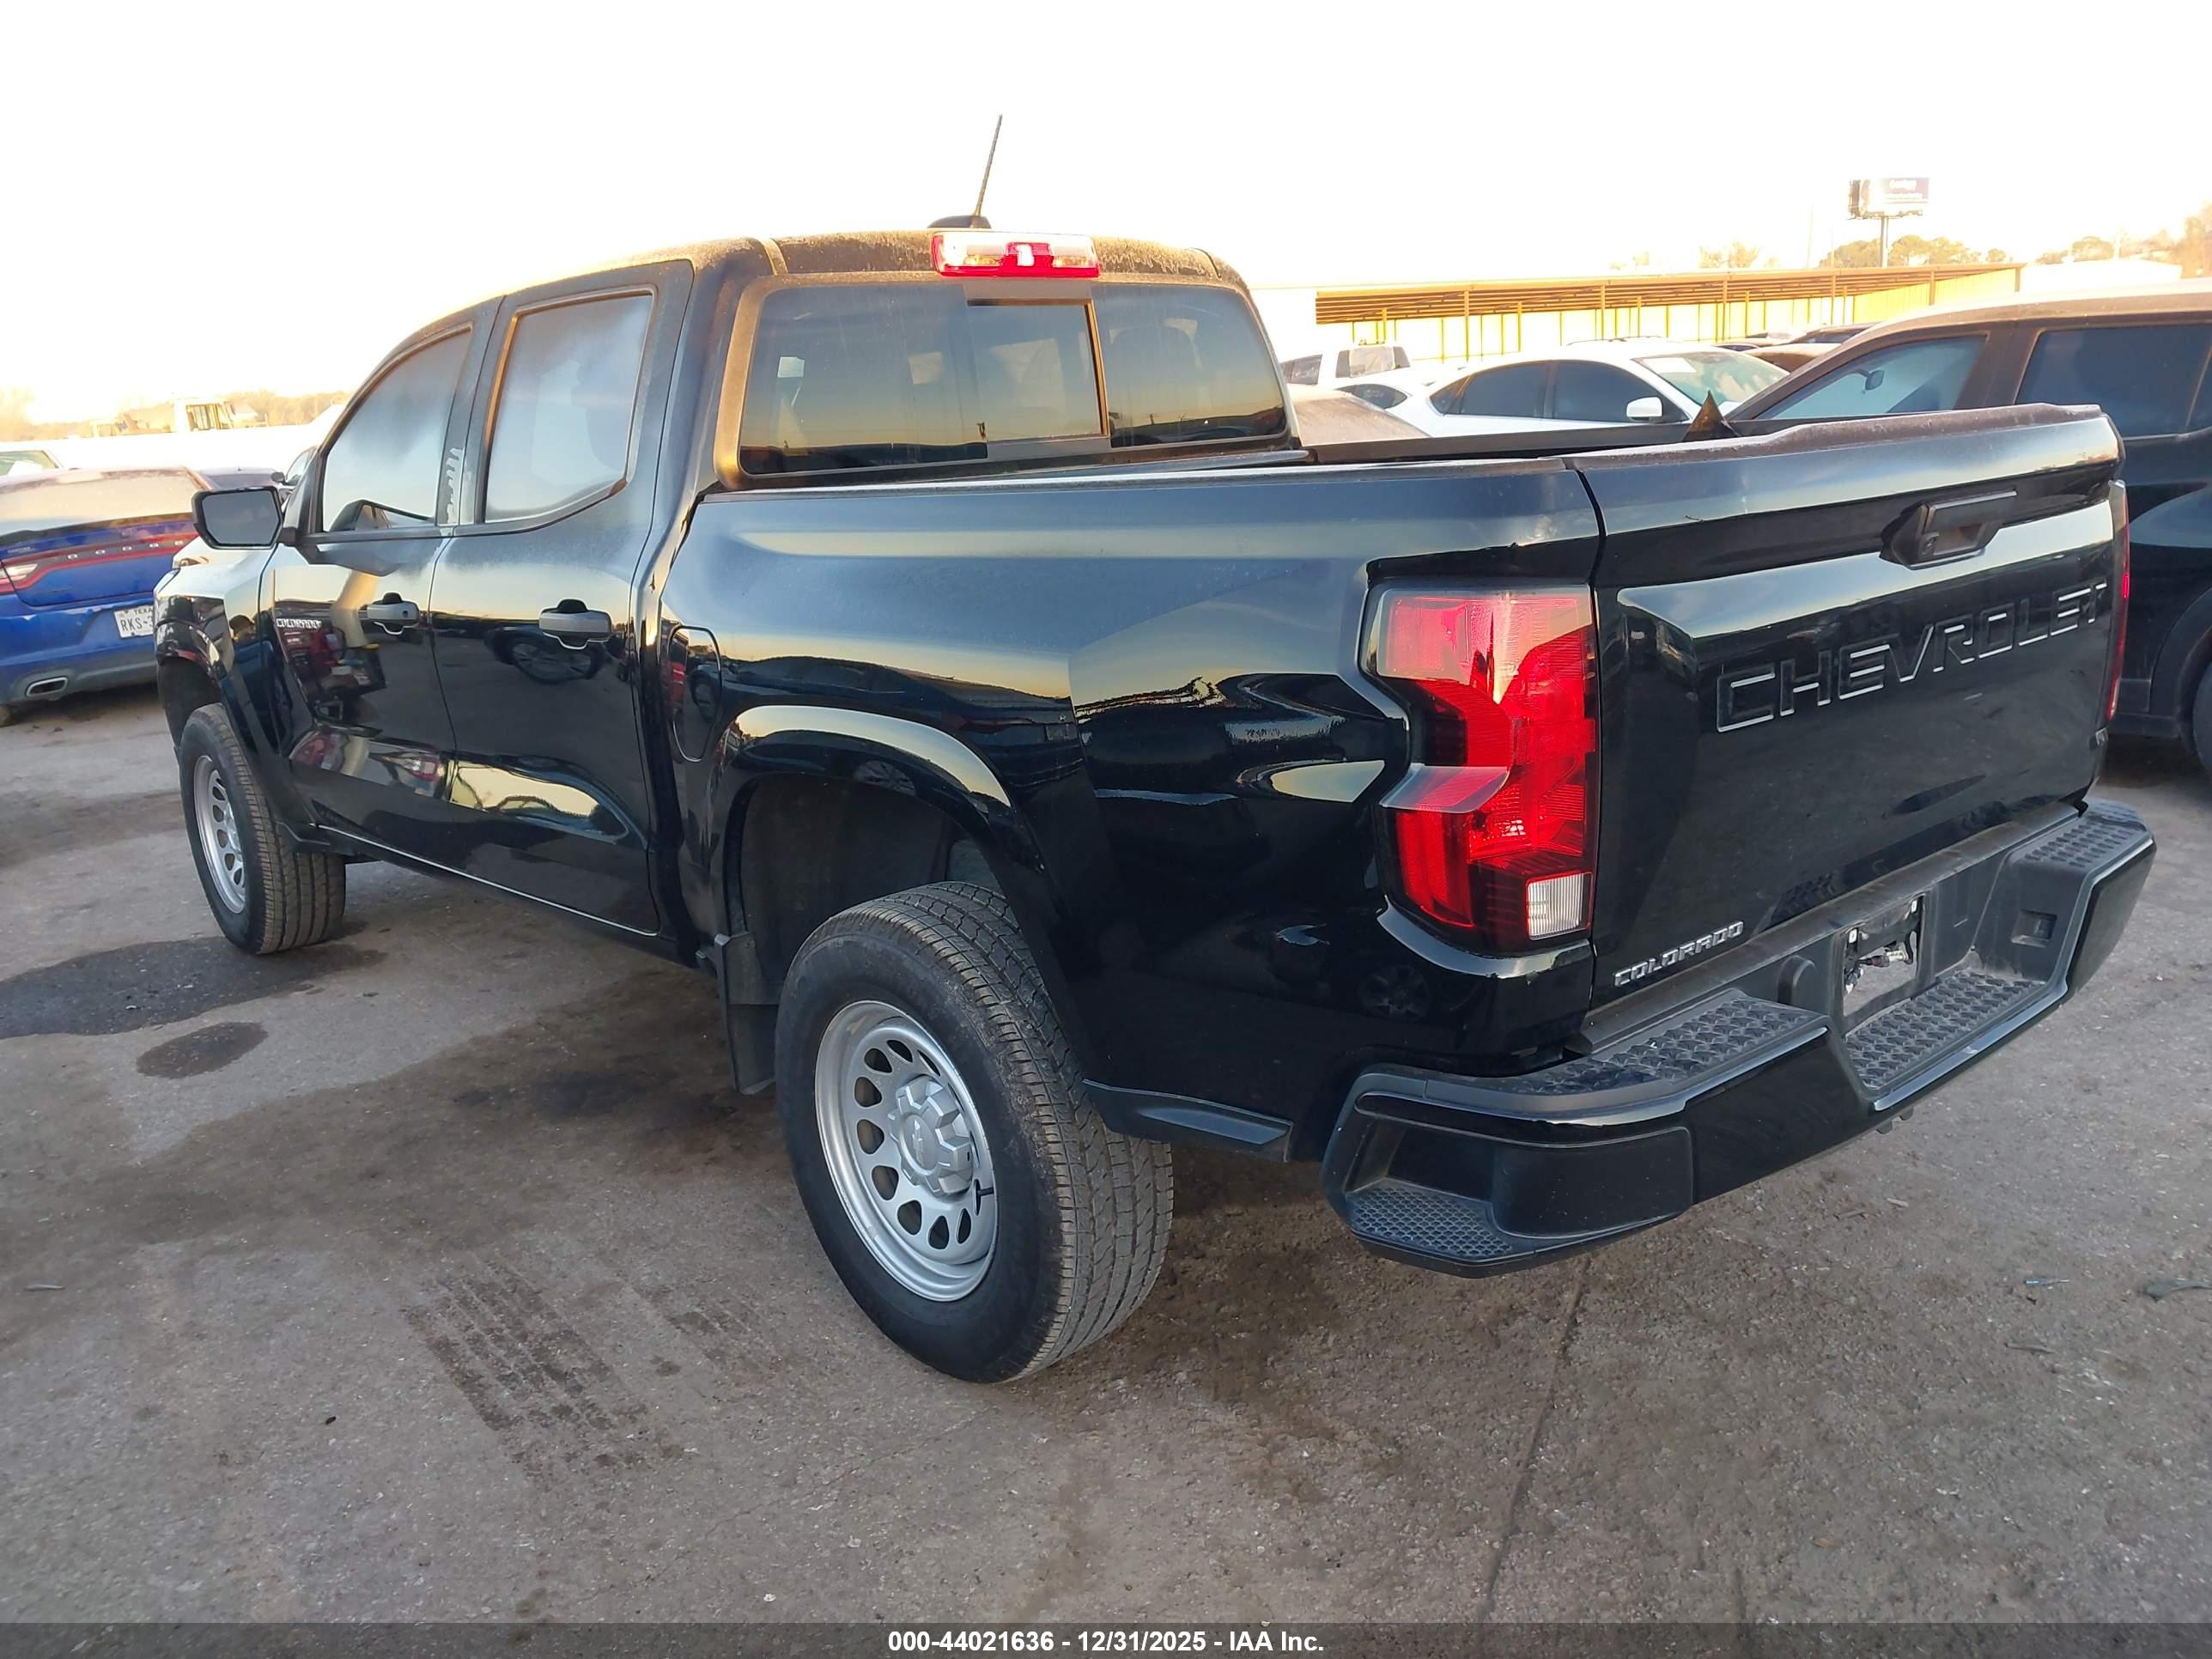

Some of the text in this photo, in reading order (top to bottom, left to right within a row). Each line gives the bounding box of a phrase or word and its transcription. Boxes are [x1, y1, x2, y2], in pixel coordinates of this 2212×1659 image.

[133, 606, 155, 616] TEXA
[1717, 581, 2107, 732] CHEVROLET
[1613, 921, 1744, 987] COLORADO
